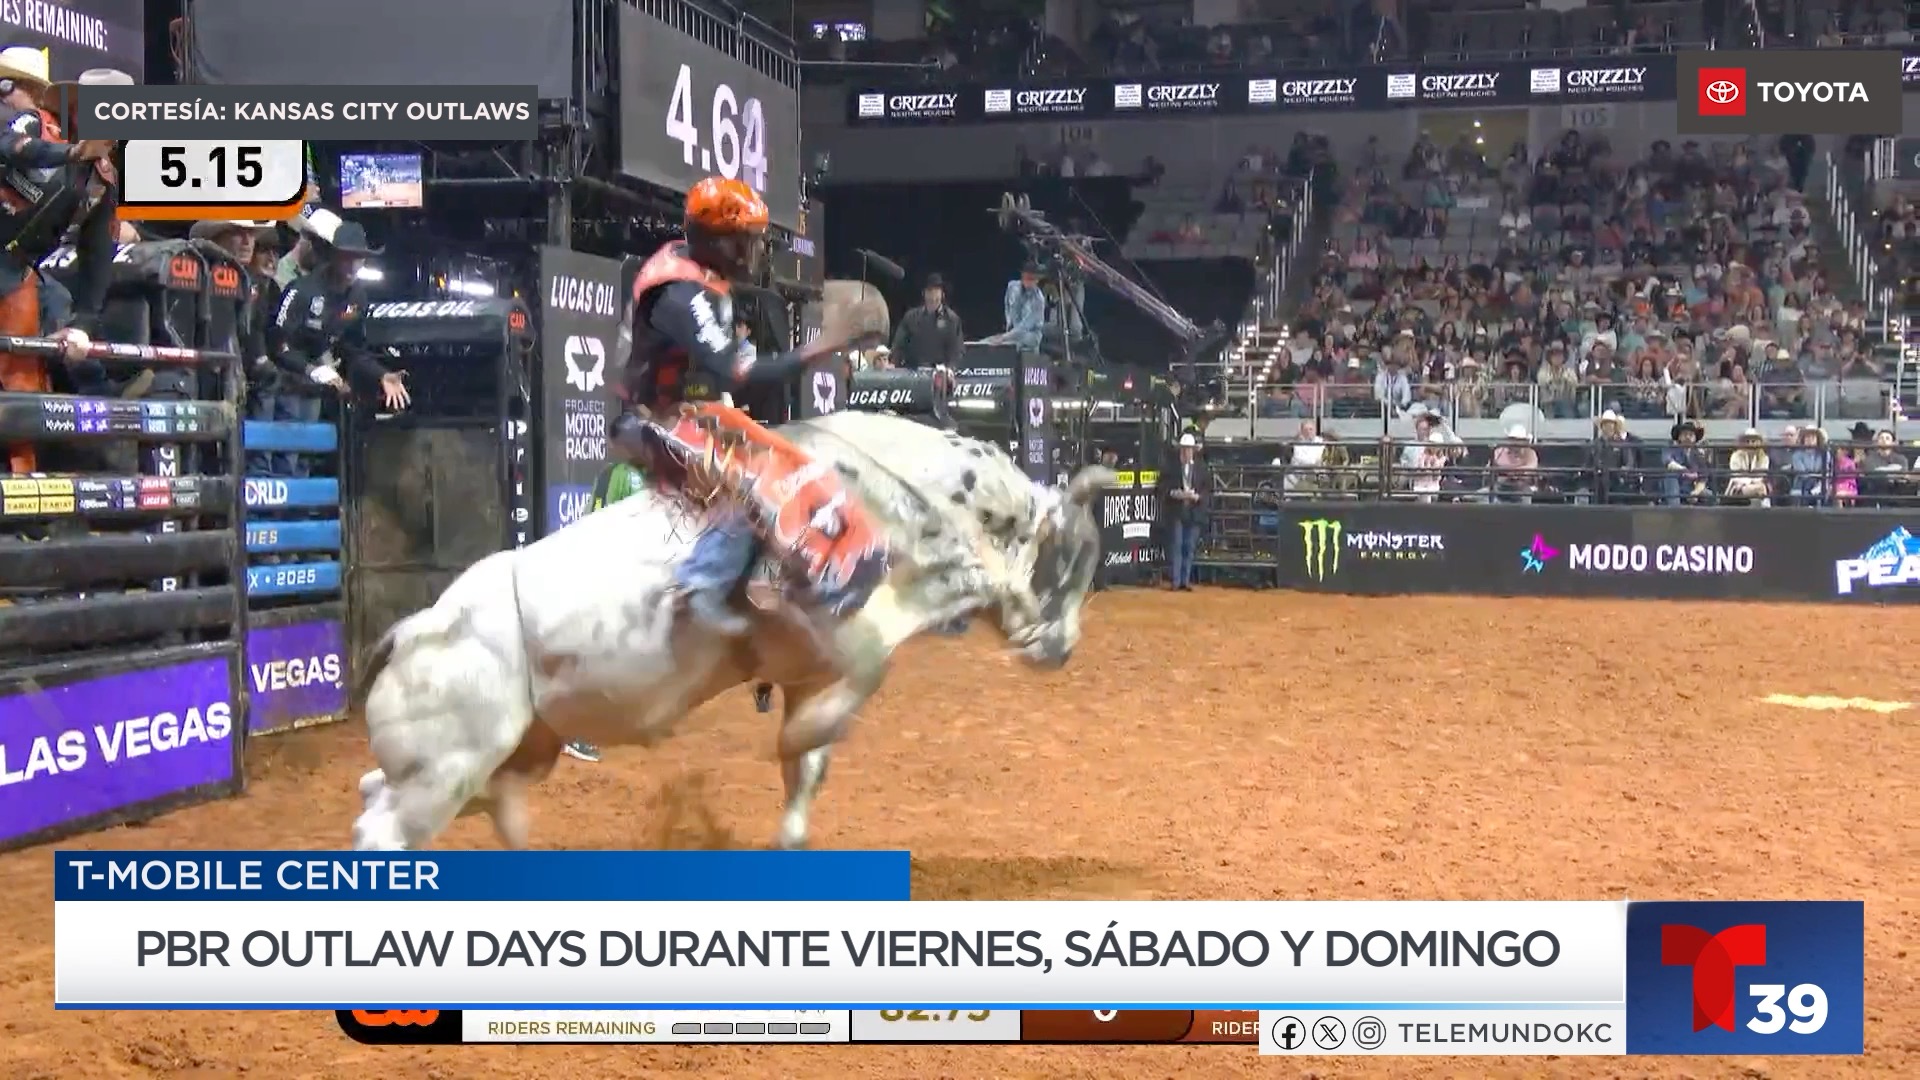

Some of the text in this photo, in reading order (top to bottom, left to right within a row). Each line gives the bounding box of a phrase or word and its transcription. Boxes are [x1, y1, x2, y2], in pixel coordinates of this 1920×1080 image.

[0, 0, 108, 52] ES REMAINING:
[1422, 72, 1500, 91] GRIZZLY
[1567, 67, 1647, 87] GRIZZLY
[1016, 88, 1087, 106] GRIZZLY
[1148, 83, 1220, 101] GRIZZLY
[1282, 78, 1357, 98] GRIZZLY
[890, 94, 957, 111] GRIZZLY
[551, 275, 615, 315] LUCAS OIL
[437, 301, 474, 317] OIL
[848, 389, 912, 405] UCAS OIL
[973, 382, 994, 396] OIL
[565, 400, 606, 412] PROJECT
[565, 413, 606, 438] MOTOR
[566, 438, 606, 460] RACING
[1103, 495, 1131, 528] HORSE
[1139, 545, 1166, 562] ULTRA
[1569, 543, 1754, 573] MODO CASINO
[276, 568, 316, 586] 2025
[251, 653, 341, 694] VEGAS
[0, 701, 232, 786] LAS VEGAS
